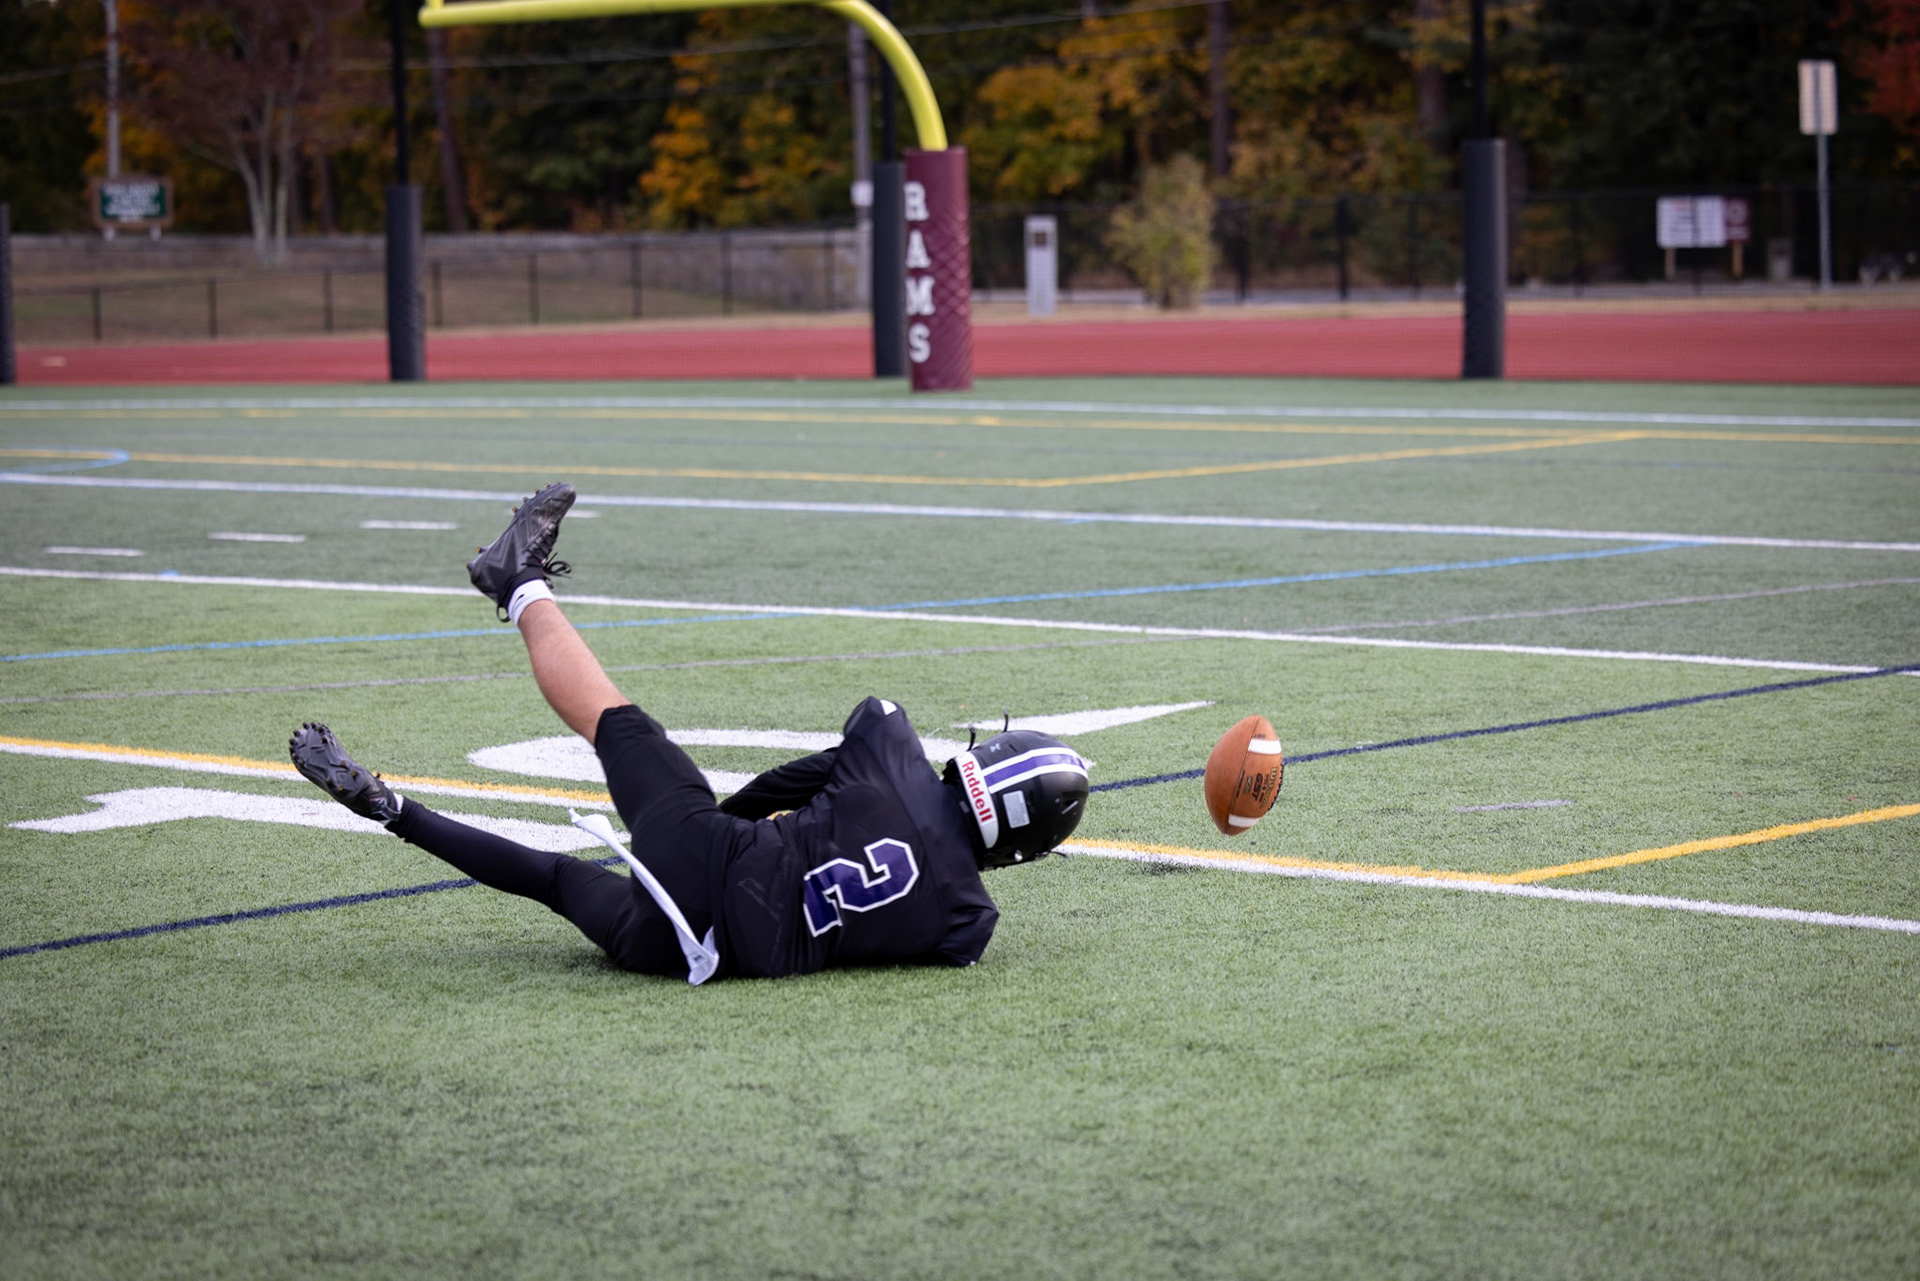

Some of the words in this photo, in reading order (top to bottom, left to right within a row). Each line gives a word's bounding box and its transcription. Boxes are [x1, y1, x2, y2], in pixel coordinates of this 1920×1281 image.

[904, 181, 936, 363] RAMS
[962, 760, 994, 822] Riddell
[803, 837, 920, 938] 2
